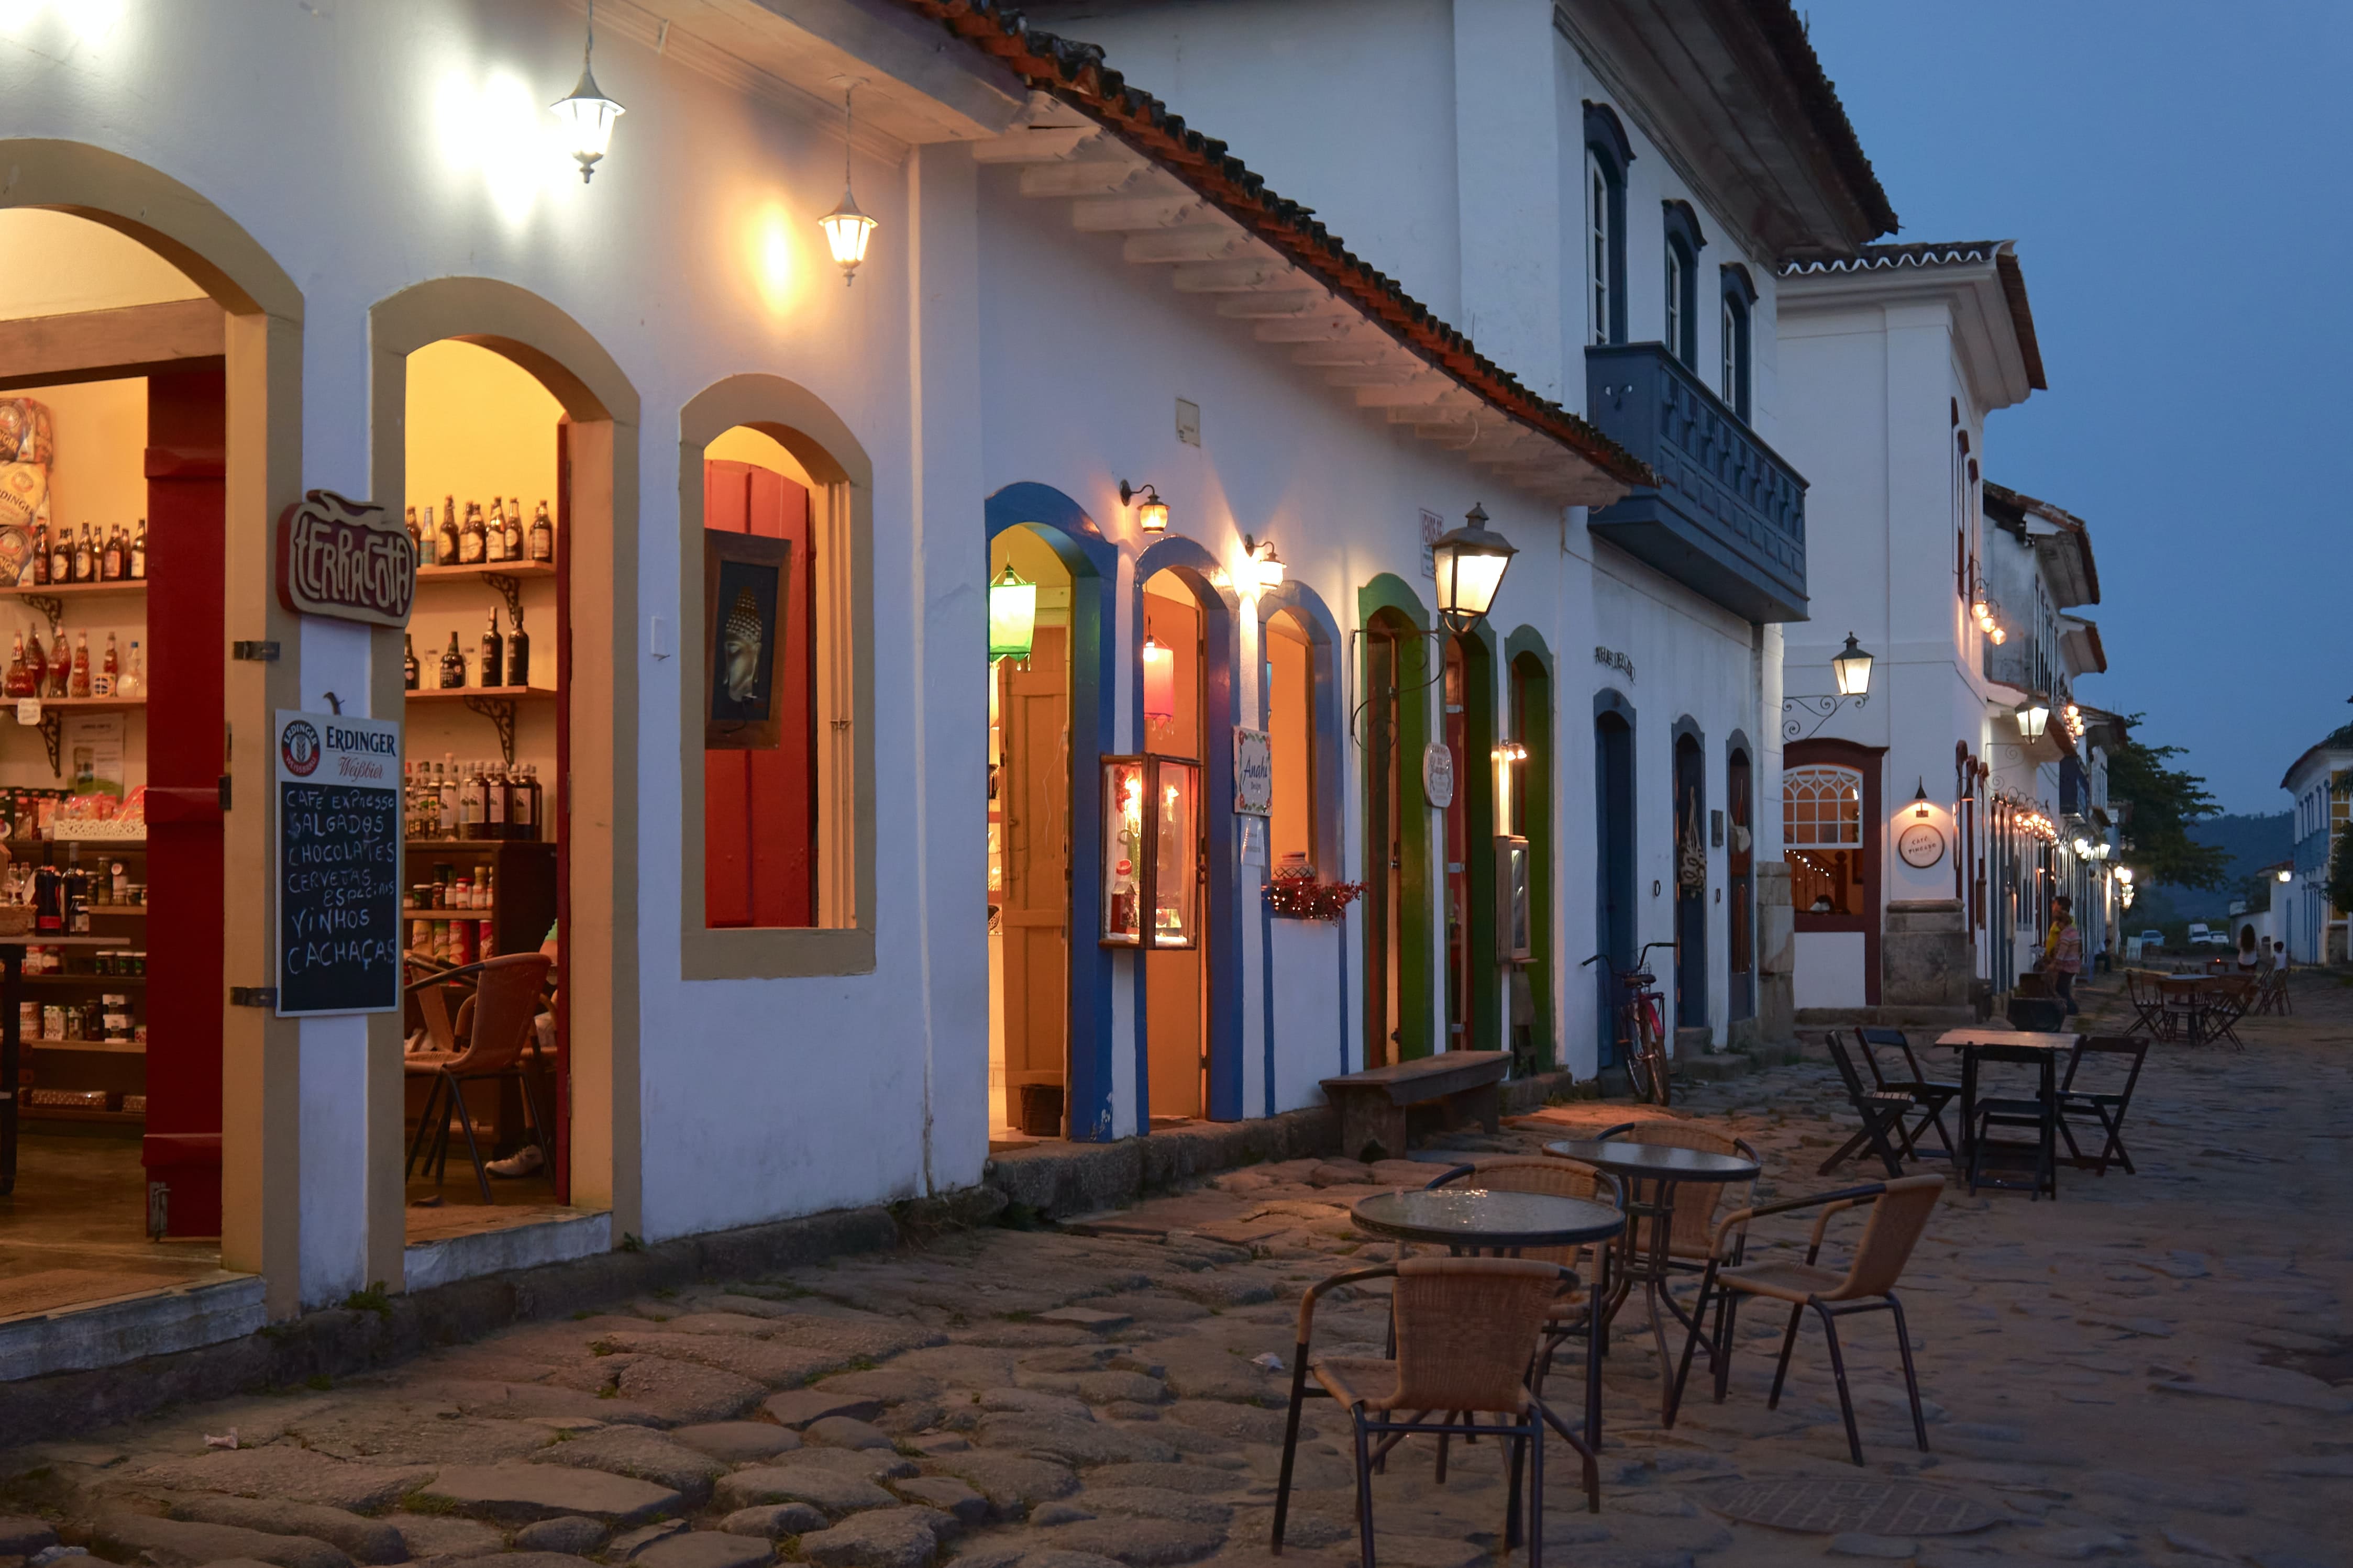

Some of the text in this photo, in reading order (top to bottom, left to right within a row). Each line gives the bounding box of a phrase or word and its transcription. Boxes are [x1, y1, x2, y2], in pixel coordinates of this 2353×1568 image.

[326, 726, 396, 757] ERDINGER
[338, 757, 384, 782] Weißbier
[286, 786, 327, 810] CAFÉ
[288, 813, 384, 838] SALGADOS
[289, 837, 394, 866] CHOCOLATES
[289, 868, 370, 893] CERVEJAS
[288, 939, 395, 974] CACHAÇAS
